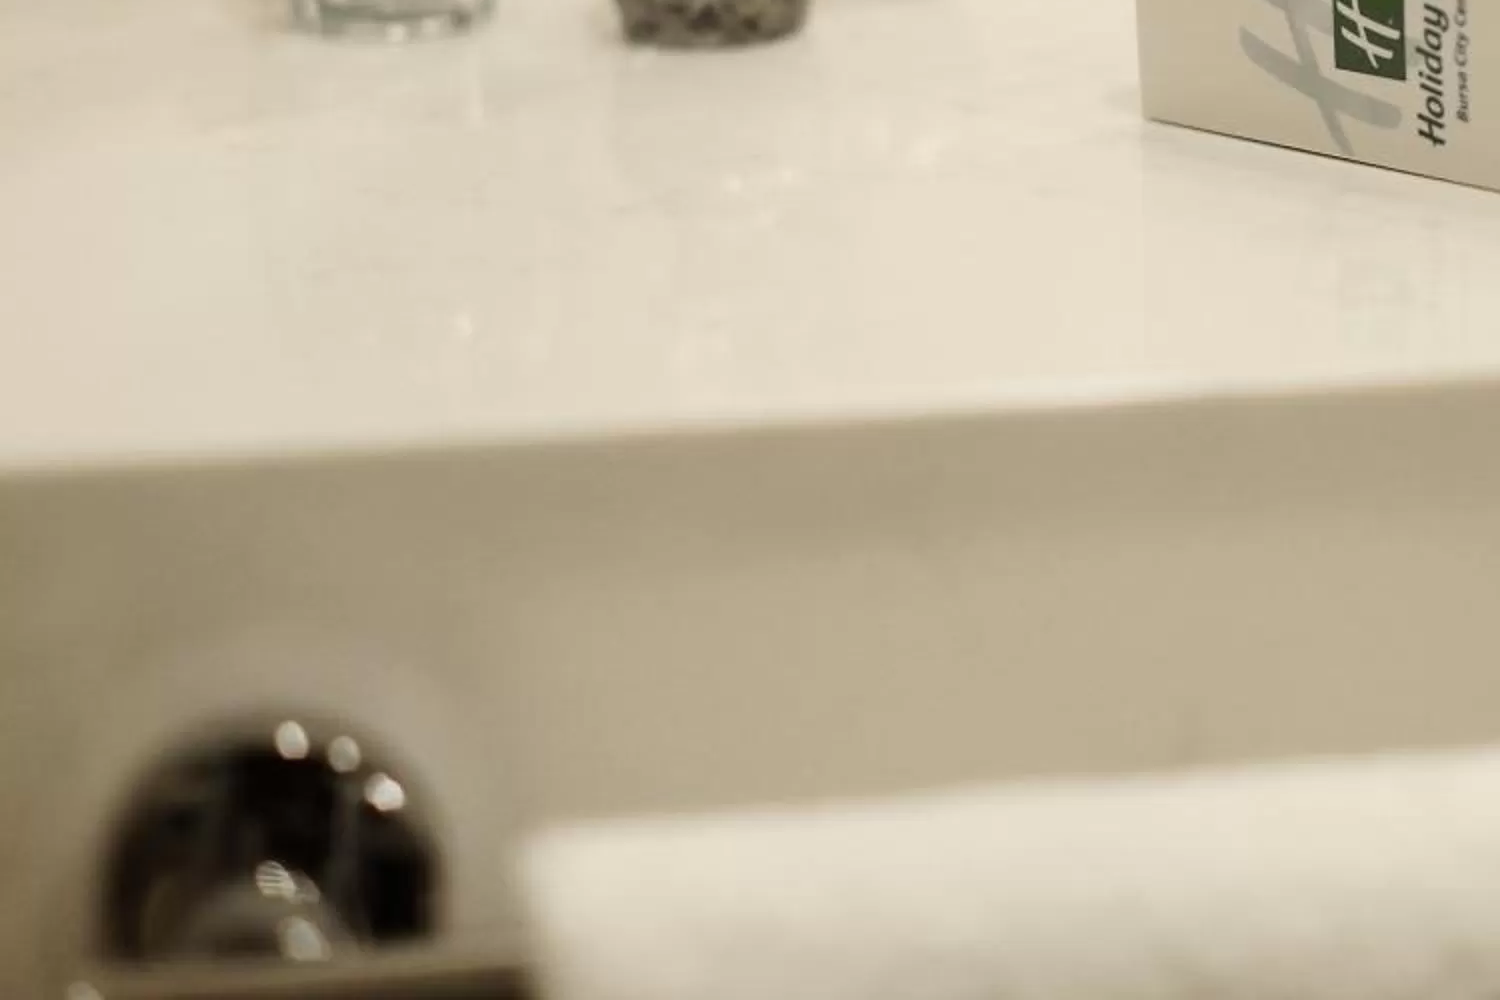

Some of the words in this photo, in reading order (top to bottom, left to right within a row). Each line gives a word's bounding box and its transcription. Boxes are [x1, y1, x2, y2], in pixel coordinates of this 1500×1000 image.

[1415, 2, 1449, 147] Holiday
[1454, 31, 1470, 67] City
[1455, 71, 1471, 123] Bursa
